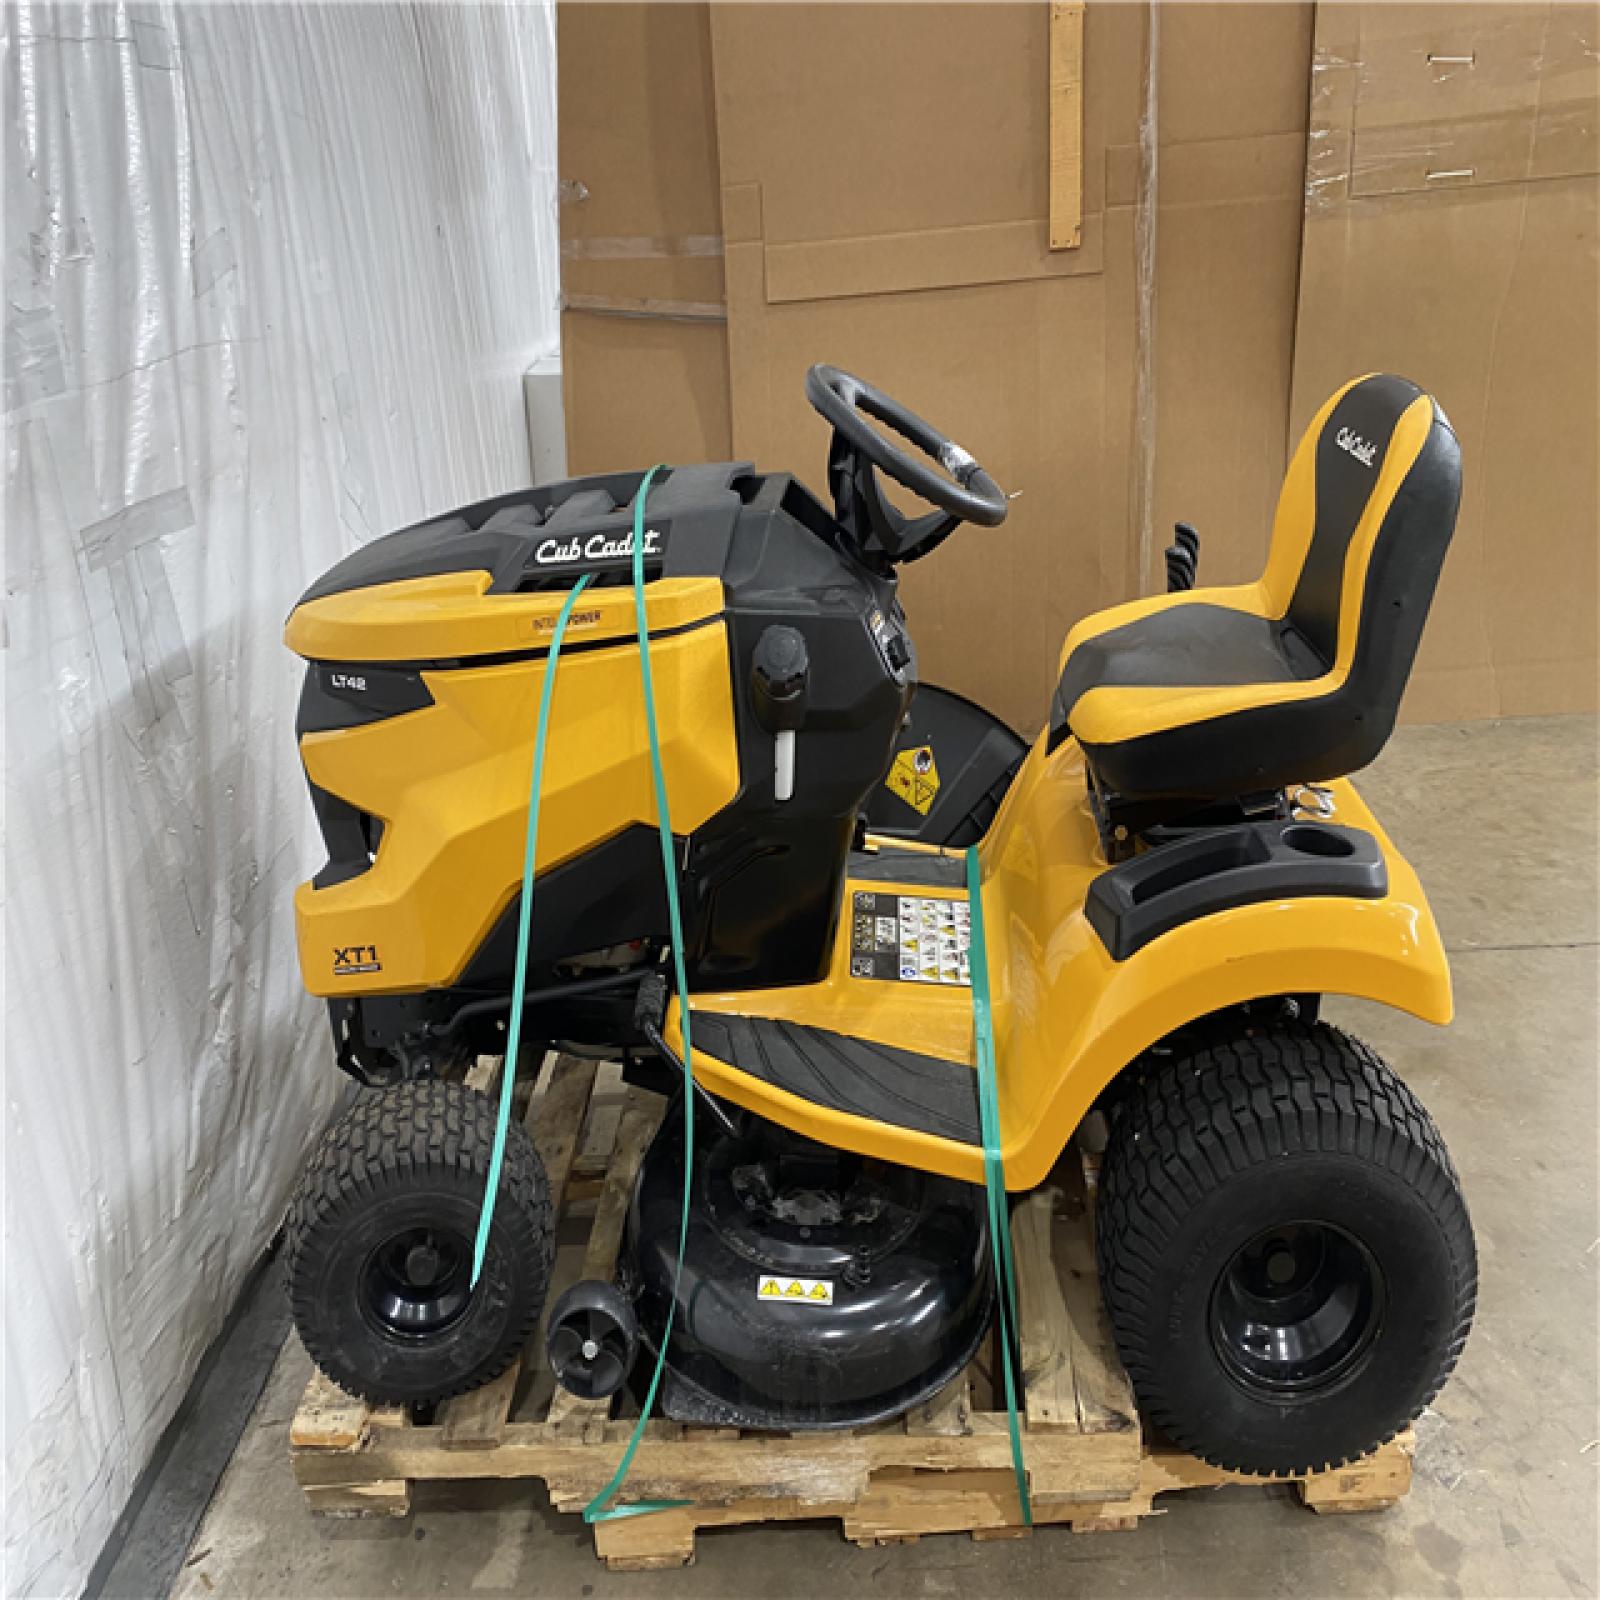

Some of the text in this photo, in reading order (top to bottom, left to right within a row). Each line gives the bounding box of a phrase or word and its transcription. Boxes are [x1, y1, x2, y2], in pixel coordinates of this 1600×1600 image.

[535, 529, 660, 564] Cub Cadt
[334, 945, 376, 965] XT1
